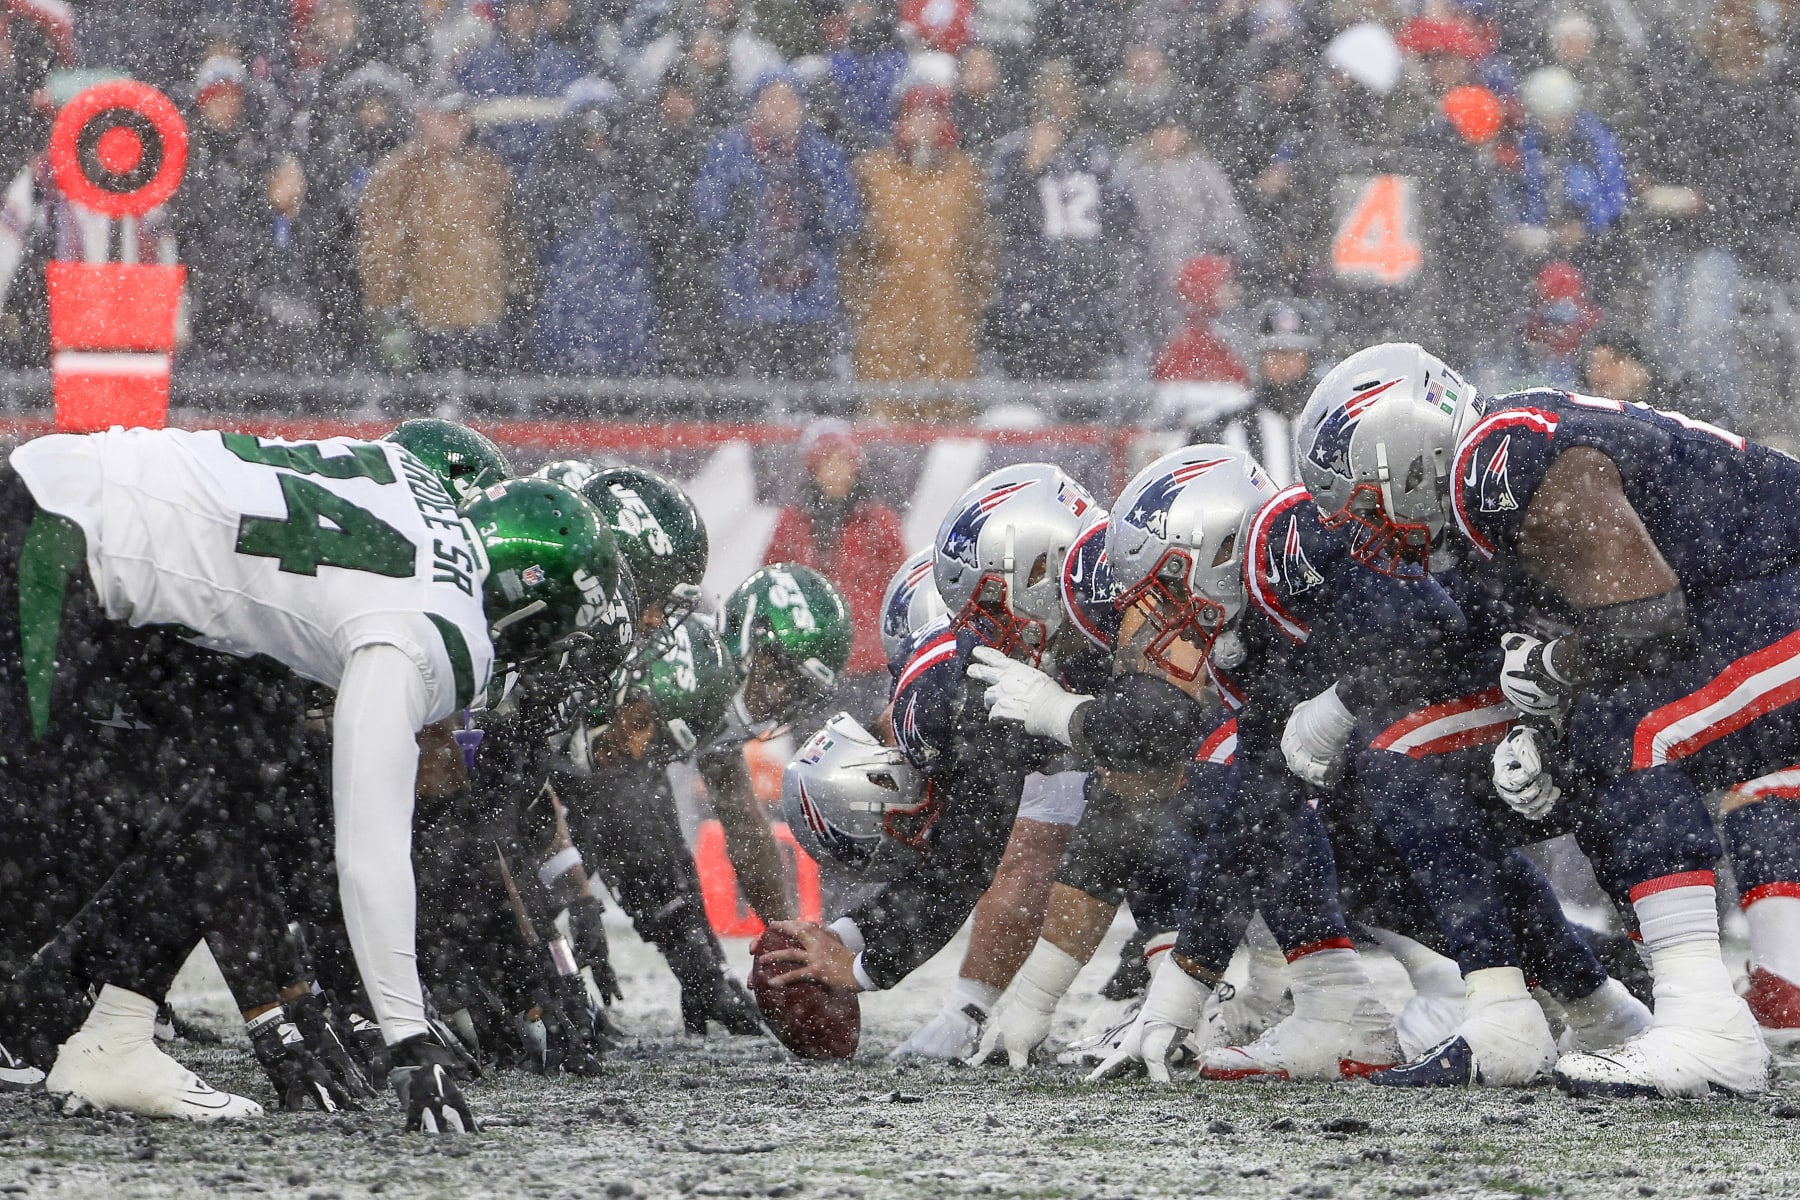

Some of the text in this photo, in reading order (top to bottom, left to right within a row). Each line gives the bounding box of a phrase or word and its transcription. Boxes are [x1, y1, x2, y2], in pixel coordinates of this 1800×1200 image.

[1037, 170, 1102, 238] 12
[1332, 174, 1422, 281] 4
[610, 483, 674, 556] JETS
[432, 537, 474, 598] SR
